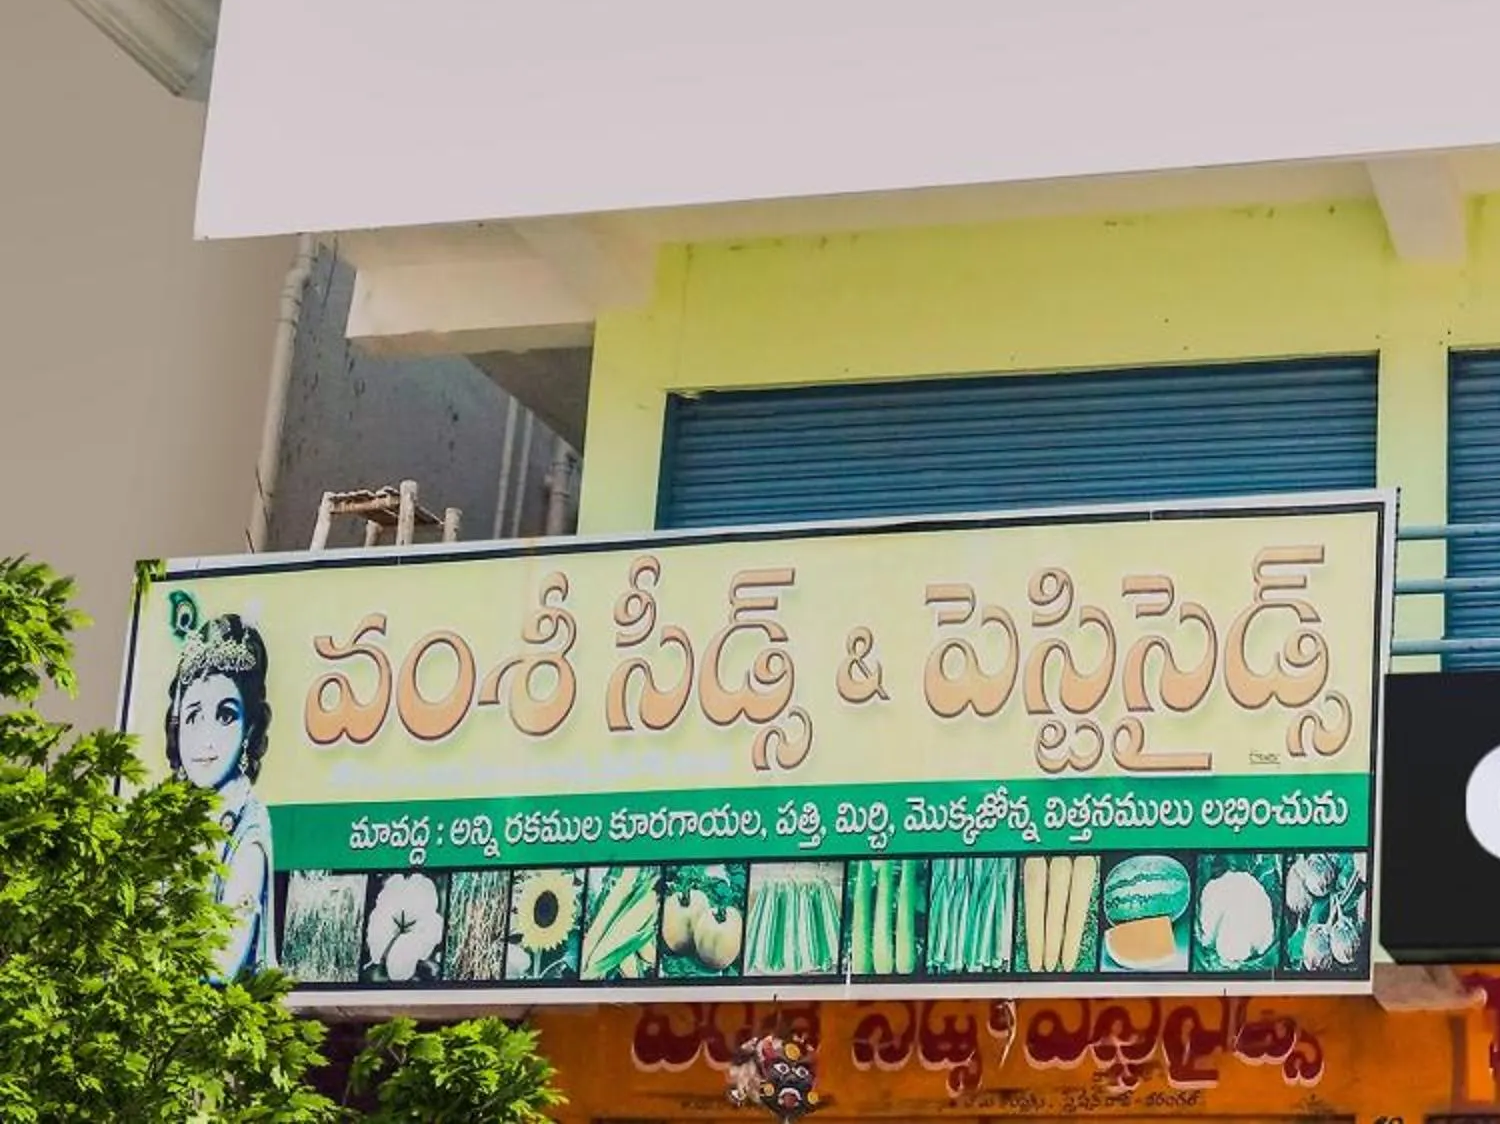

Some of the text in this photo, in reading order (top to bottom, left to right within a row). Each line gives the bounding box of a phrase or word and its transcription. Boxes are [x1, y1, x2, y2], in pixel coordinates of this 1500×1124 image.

[304, 570, 578, 747] వంశీ
[605, 555, 814, 772] సీడ్స్
[836, 626, 891, 704] &
[450, 814, 500, 857] అన్ని
[504, 809, 602, 845] రకముల
[1044, 790, 1195, 842] విత్తనములు
[1200, 789, 1349, 833] లభించును
